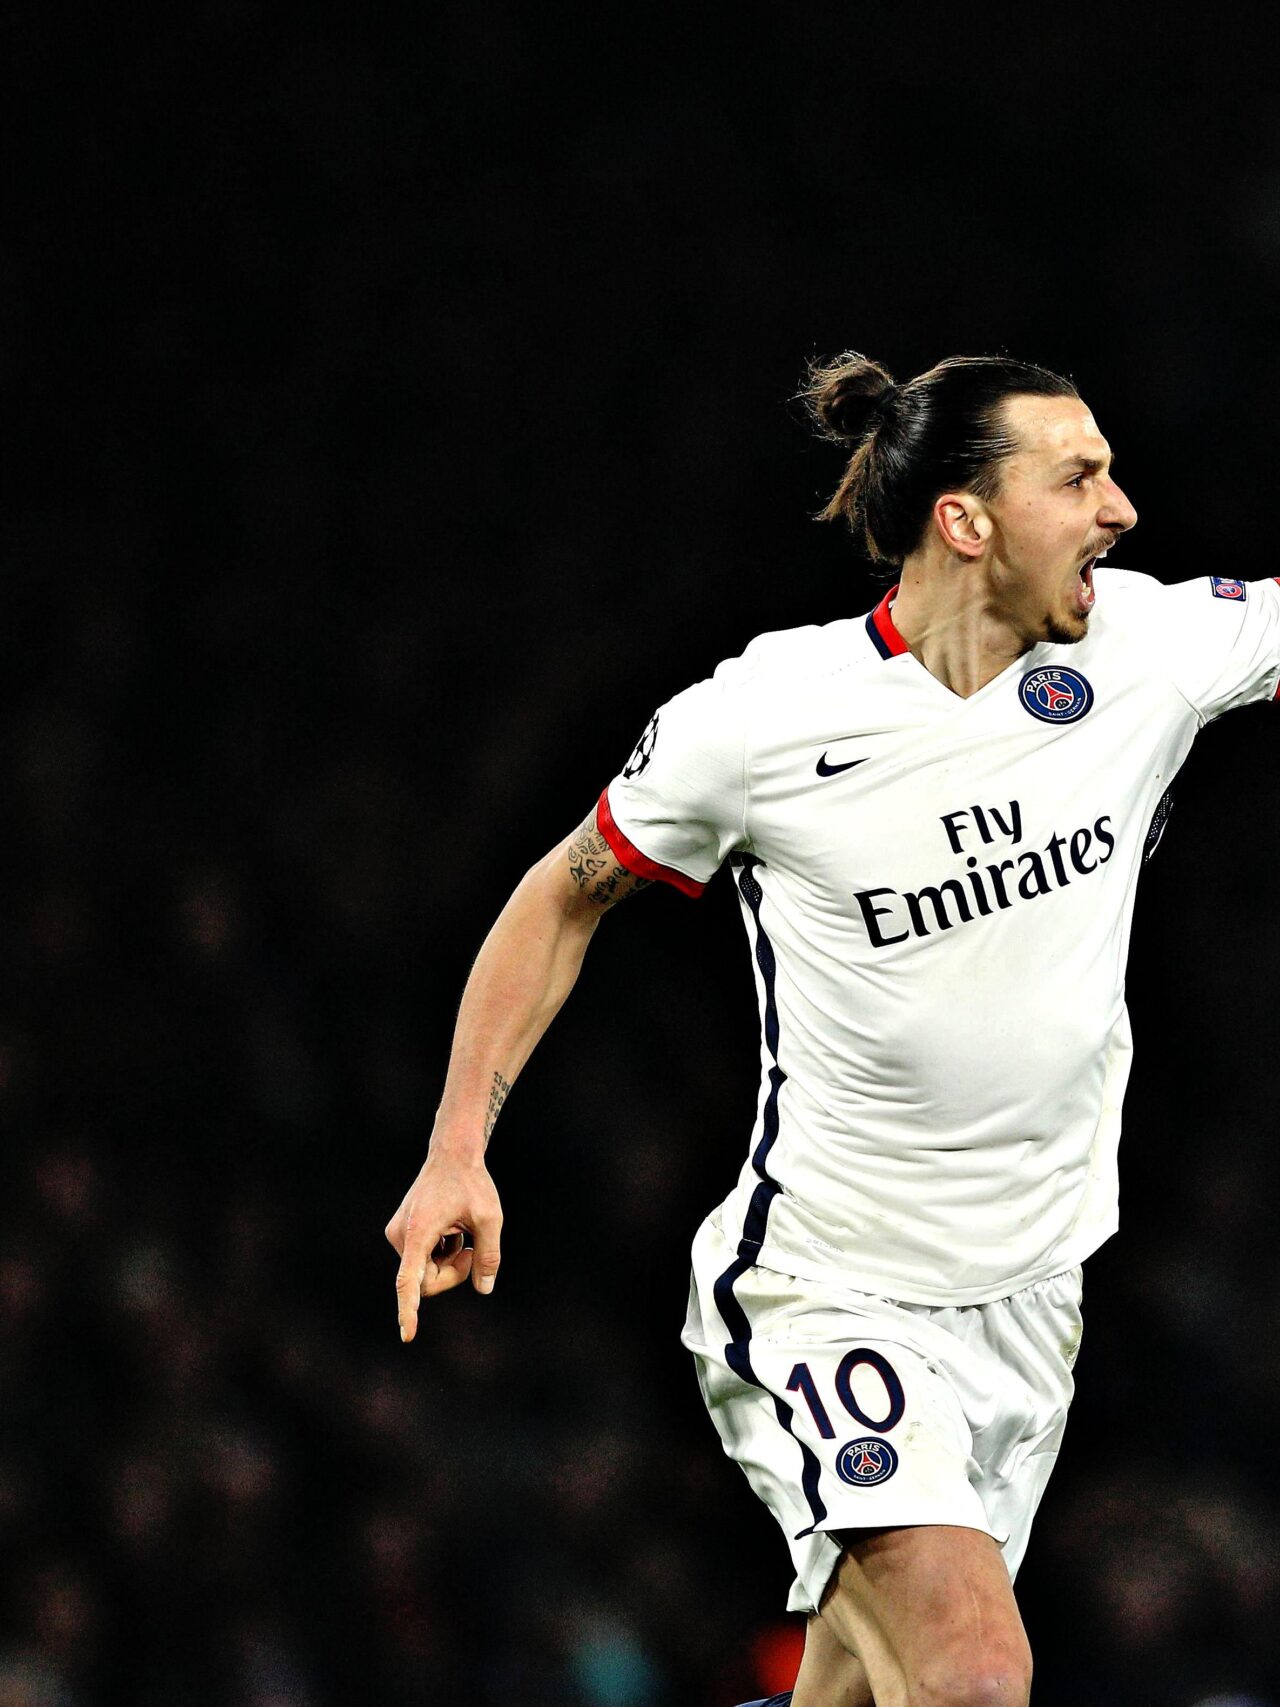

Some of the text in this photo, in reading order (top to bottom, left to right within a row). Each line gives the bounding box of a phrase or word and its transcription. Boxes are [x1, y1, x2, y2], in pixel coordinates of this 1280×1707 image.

[1026, 672, 1062, 693] PARIS
[939, 799, 1023, 854] Fly
[852, 815, 1116, 948] Emirates
[785, 1347, 906, 1440] 10
[847, 1443, 881, 1457] PARIS
